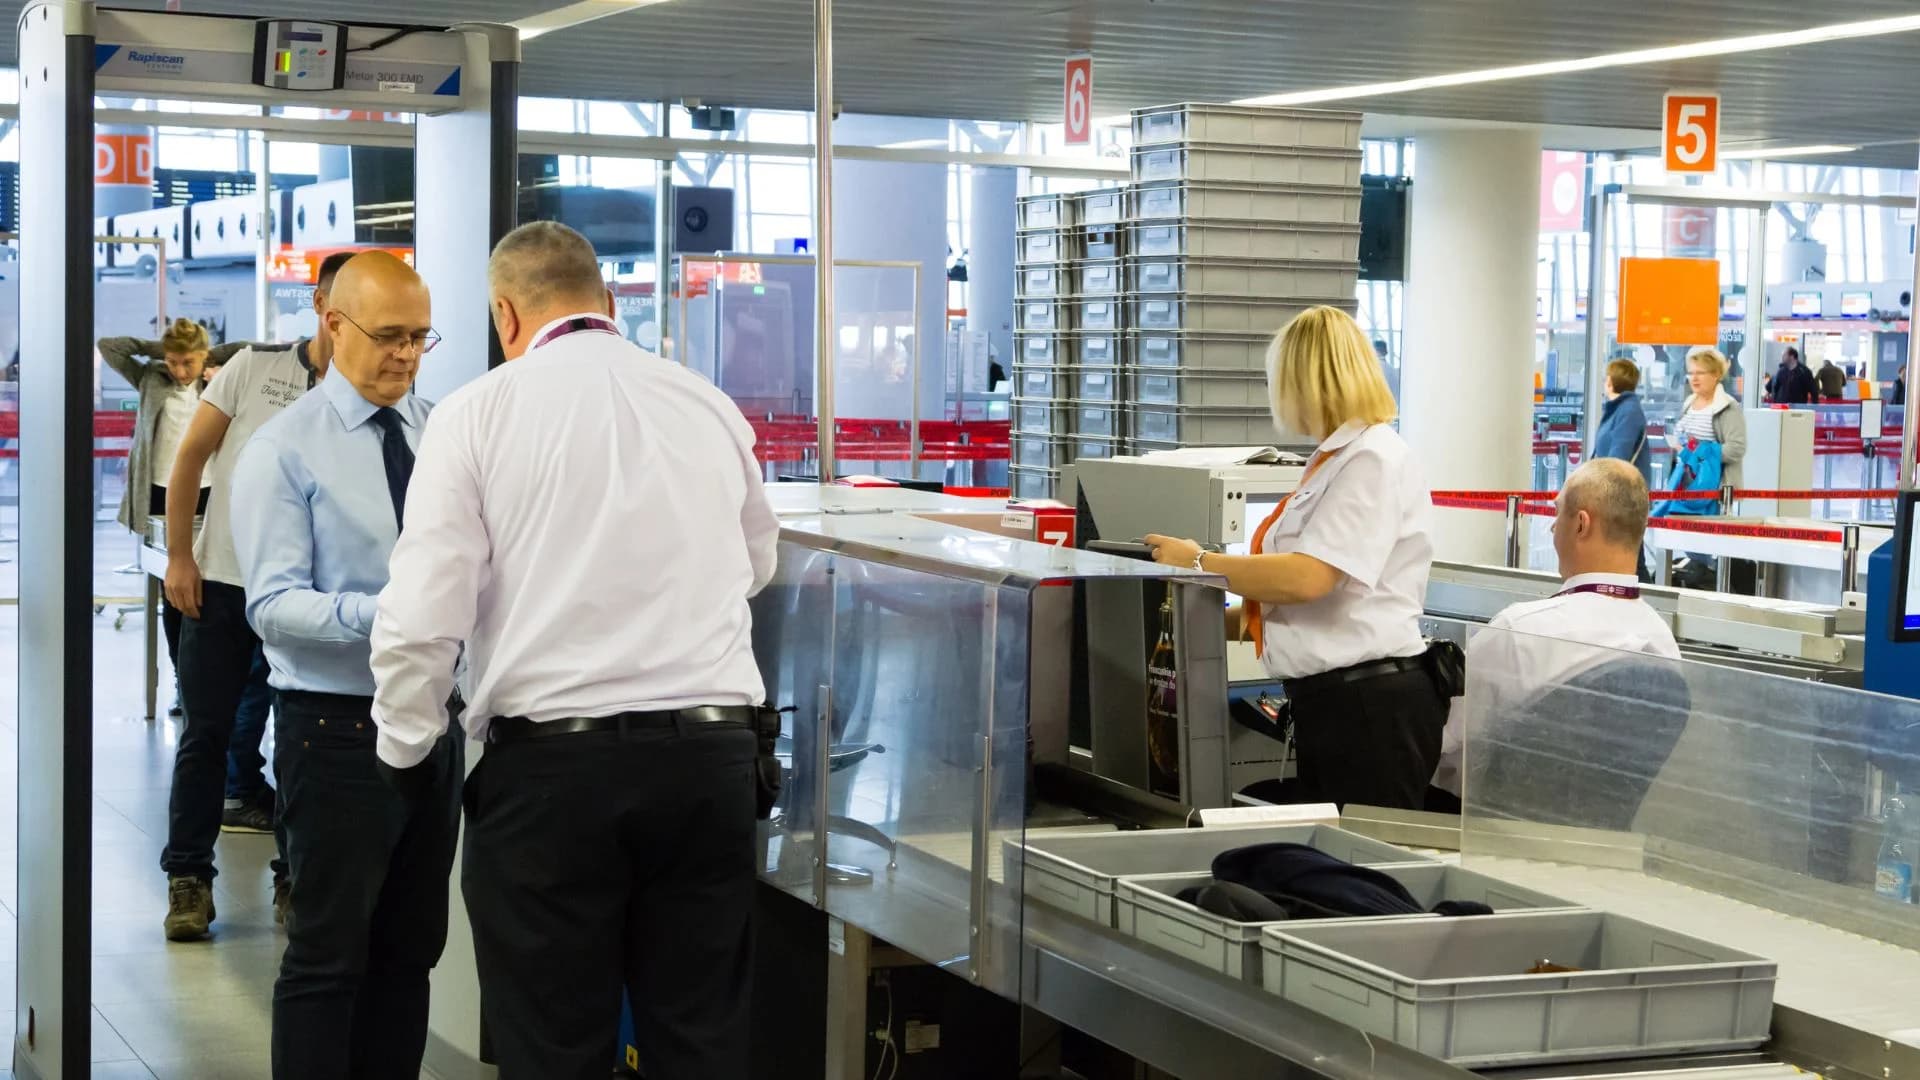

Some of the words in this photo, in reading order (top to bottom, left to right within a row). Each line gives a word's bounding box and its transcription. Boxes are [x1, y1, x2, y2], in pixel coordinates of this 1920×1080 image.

[128, 51, 185, 65] Rapiscan
[377, 72, 399, 83] 300
[400, 74, 425, 85] EMD
[1069, 67, 1086, 135] 6
[1674, 103, 1708, 165] 5
[1680, 213, 1701, 242] C
[1680, 520, 1715, 533] WARSAW
[1758, 528, 1789, 538] CHOPIN
[1791, 530, 1827, 541] AIRPORT
